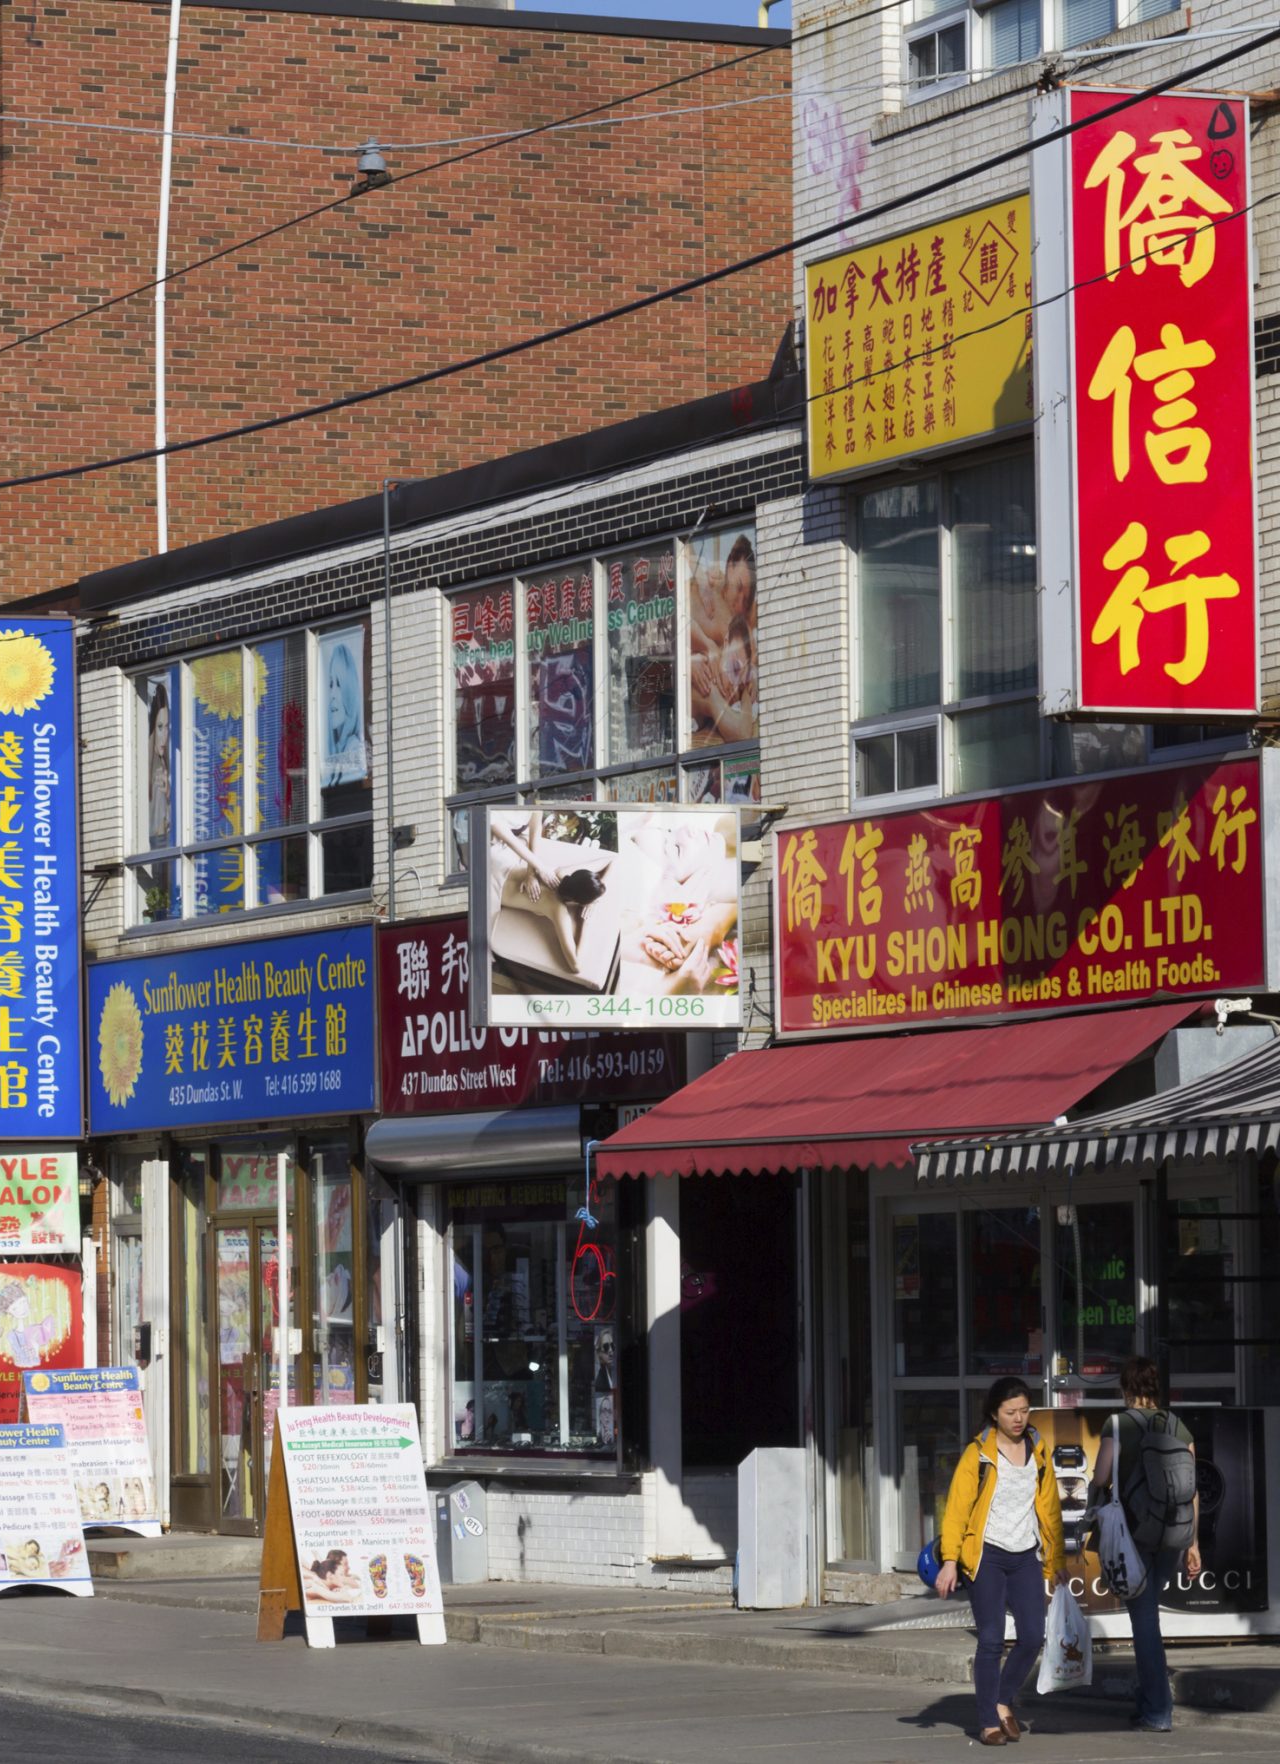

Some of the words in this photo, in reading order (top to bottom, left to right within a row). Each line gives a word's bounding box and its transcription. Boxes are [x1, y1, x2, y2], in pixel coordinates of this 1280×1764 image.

[812, 235, 948, 323] 加拿大特產
[1084, 129, 1240, 686] 僑信行
[32, 722, 58, 848] Sunflower
[32, 855, 60, 936] Health
[817, 934, 877, 984] KYU
[886, 923, 966, 975] SHON
[976, 911, 1068, 967] HONG
[1077, 902, 1132, 956] CO.
[1144, 893, 1212, 948] LTD.
[31, 945, 58, 1028] Beauty
[144, 971, 211, 1015] Sunflower
[214, 961, 261, 1006] Health
[265, 960, 313, 1004] Beauty
[317, 953, 366, 993] Centre
[526, 1000, 571, 1016] (647)
[587, 997, 705, 1016] 344-1086
[813, 987, 906, 1027] Specializes
[911, 985, 928, 1013] In
[932, 980, 1003, 1011] Chinese
[1008, 971, 1061, 1003] Herbs
[1067, 968, 1082, 996] &
[1087, 961, 1151, 995] Health
[1157, 956, 1220, 987] Foods.
[164, 1003, 347, 1075] 葵花美容養生館
[37, 1035, 61, 1118] Centre
[170, 1085, 185, 1105] 435
[187, 1081, 219, 1105] Dundas
[220, 1082, 232, 1101] St.
[233, 1080, 243, 1099] W.
[265, 1076, 280, 1096] Tel:
[281, 1074, 298, 1093] 416
[300, 1073, 317, 1092] 599
[319, 1070, 341, 1091] 1688
[401, 1072, 419, 1095] 437
[421, 1072, 458, 1094] Dundas
[460, 1068, 487, 1090] Street
[490, 1064, 517, 1087] West
[539, 1058, 564, 1084] Tel:
[568, 1049, 665, 1081] 416-593-0159
[52, 1373, 99, 1384] Sunflower
[101, 1371, 133, 1380] Health
[63, 1382, 93, 1391] Beauty
[94, 1381, 125, 1390] Centre
[19, 1437, 50, 1446] Centre
[26, 1427, 60, 1436] Health
[296, 1418, 312, 1429] Feng
[313, 1412, 336, 1424] Health
[337, 1411, 361, 1422] Beauty
[363, 1412, 410, 1429] Development
[296, 1476, 329, 1485] SHIATSU
[331, 1475, 369, 1483] MASSAGE
[317, 1498, 349, 1506] Massage
[347, 1509, 382, 1517] MASSAGE
